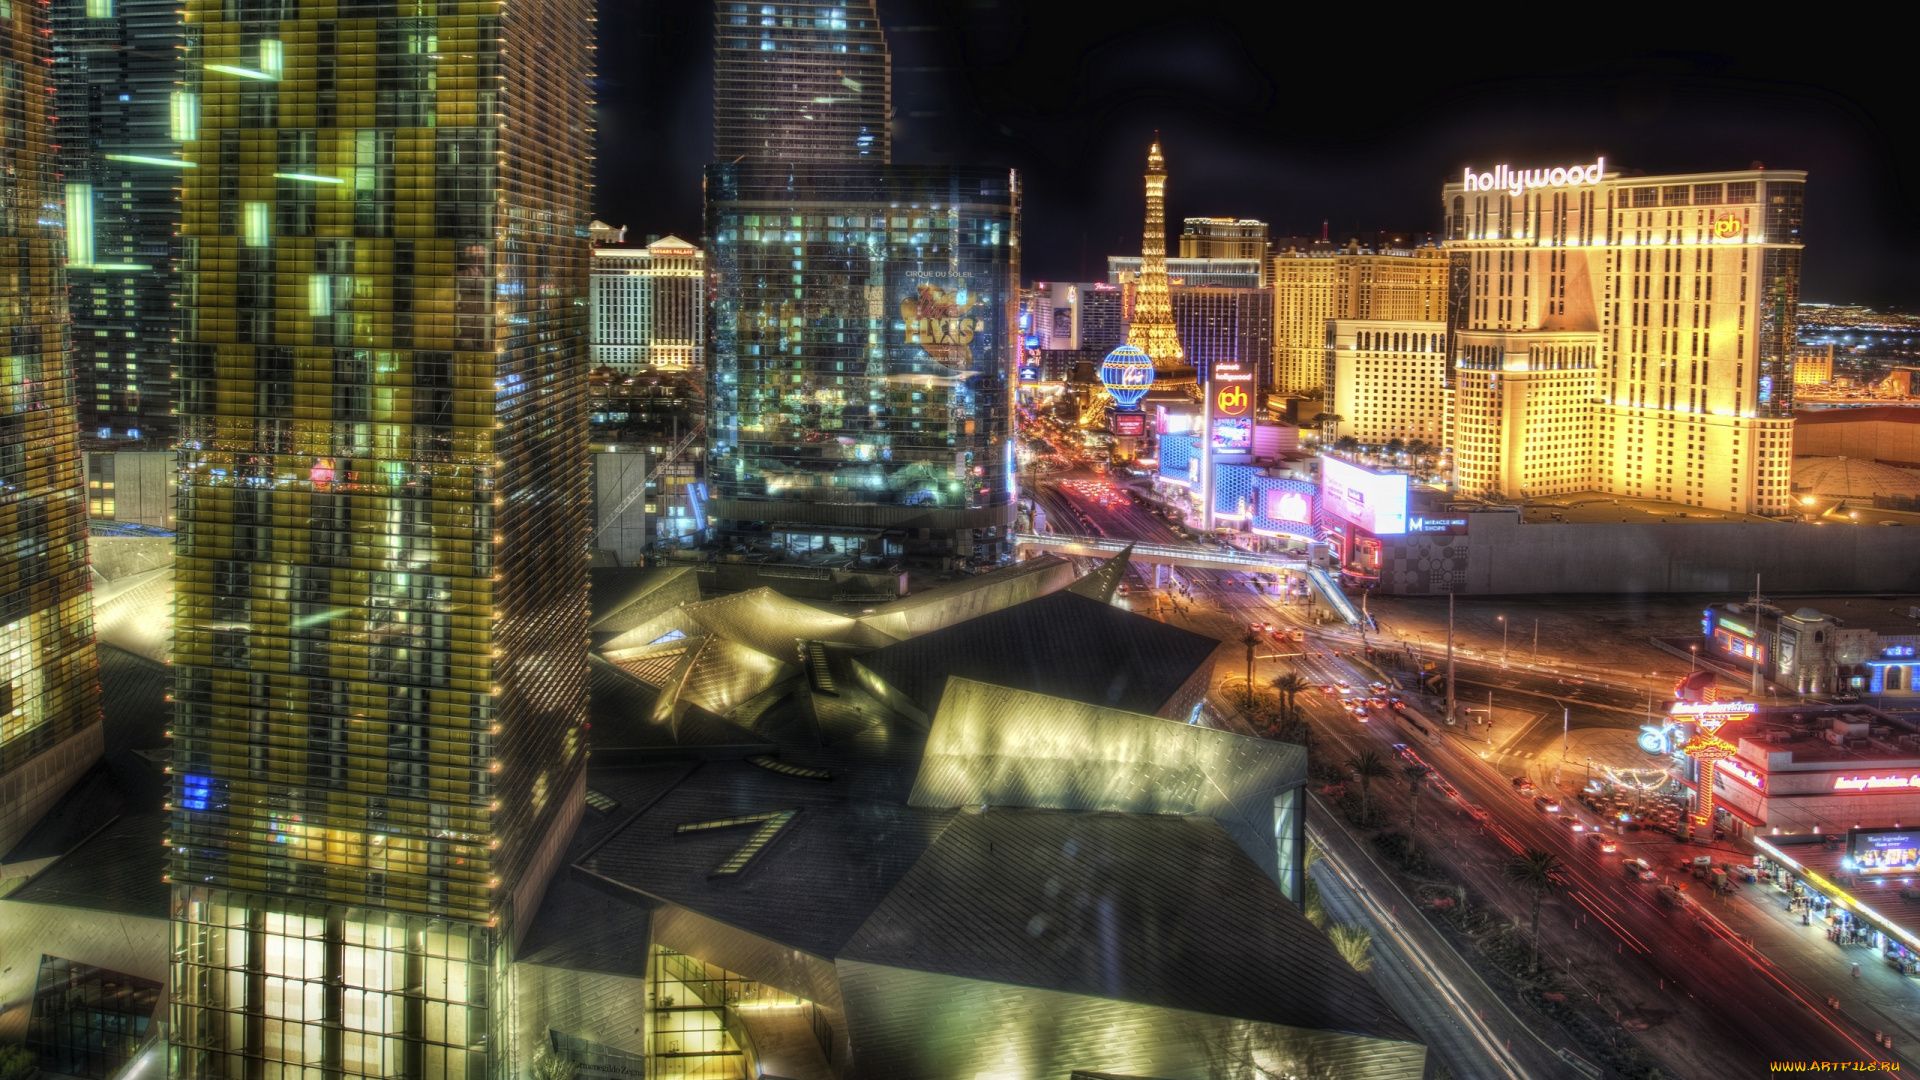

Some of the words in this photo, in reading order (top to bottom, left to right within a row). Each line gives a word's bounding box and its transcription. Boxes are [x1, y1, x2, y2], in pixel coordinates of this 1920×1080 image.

[1463, 156, 1605, 196] hollywood
[1717, 214, 1740, 236] ph
[904, 317, 975, 344] ELVIS
[1215, 363, 1240, 372] planet
[1215, 373, 1252, 381] hollywood
[1221, 386, 1248, 412] ph
[1409, 517, 1423, 531] M
[1882, 835, 1910, 843] legendary
